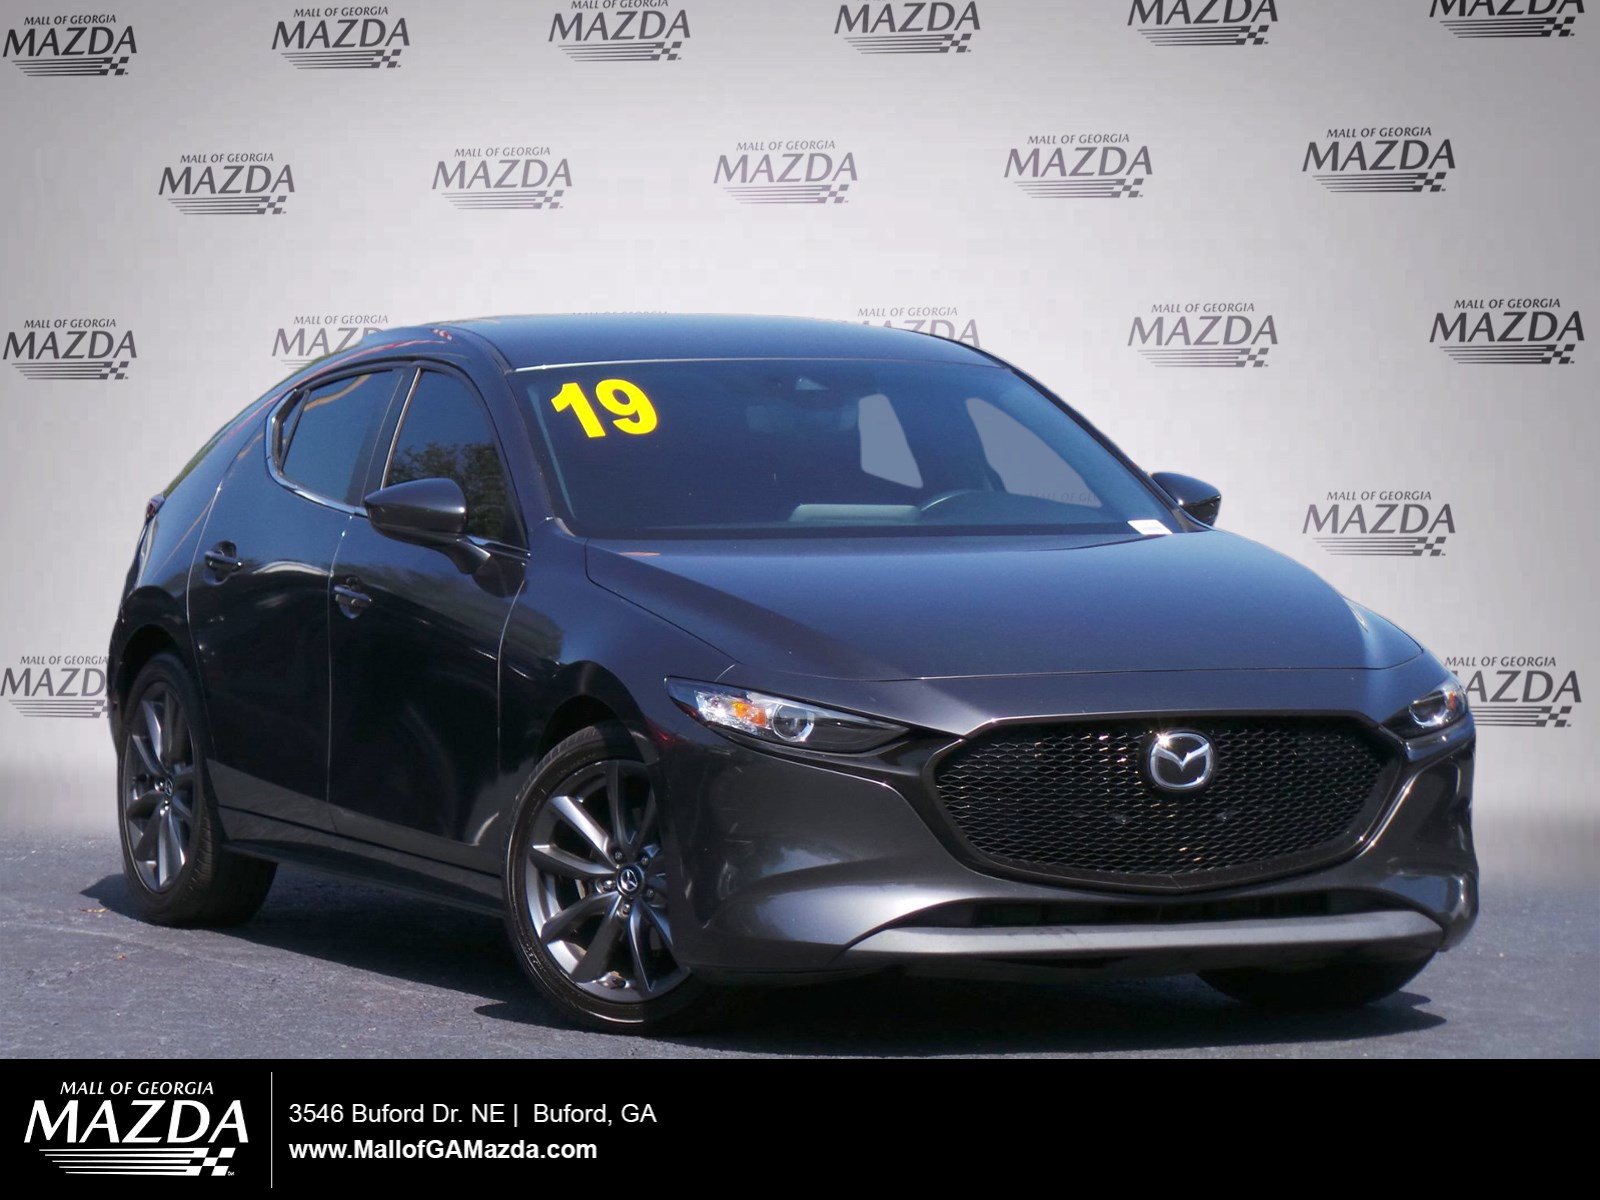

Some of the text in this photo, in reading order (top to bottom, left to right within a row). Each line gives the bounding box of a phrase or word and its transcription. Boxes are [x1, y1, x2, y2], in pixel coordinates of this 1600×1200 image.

[293, 6, 389, 18] MALL OF GEORGIA
[570, 0, 669, 10] MALL OF GEORGIA
[833, 1, 981, 35] MAZDA
[1127, 0, 1279, 27] MAZDA
[23, 13, 117, 26] MALL OF GEORGIA
[547, 9, 691, 43] MAZDA
[2, 25, 138, 58] MAZDA
[271, 17, 411, 51] MAZDA
[736, 140, 836, 151] MALL OF GEORGIA
[1027, 133, 1130, 145] MALL OF GEORGIA
[1326, 126, 1432, 139] MALL OF GEORGIA
[179, 152, 275, 164] MALL OF GEORGIA
[453, 146, 552, 158] MALL OF GEORGIA
[1003, 145, 1153, 178] MAZDA
[1302, 138, 1456, 172] MAZDA
[157, 164, 295, 196] MAZDA
[431, 158, 573, 190] MAZDA
[713, 151, 858, 184] MAZDA
[857, 307, 959, 317] MALL OF GEORGIA
[1151, 302, 1255, 313] MALL OF GEORGIA
[1453, 297, 1561, 310] MALL OF GEORGIA
[23, 318, 117, 329] MALL OF GEORGIA
[293, 315, 389, 325] MALL OF GEORGIA
[1128, 314, 1279, 347] MAZDA
[1430, 310, 1586, 343] MAZDA
[2, 329, 138, 361] MAZDA
[271, 327, 384, 357] MAZ
[550, 378, 658, 438] 19
[1326, 490, 1432, 501] MALL OF GEORGIA
[1303, 503, 1456, 534] MAZDA
[20, 655, 108, 665] MALL OF GEORGIA
[1445, 656, 1557, 667] MALL OF GEORGIA
[0, 667, 107, 697] MAZD
[1451, 669, 1583, 704] AZDA
